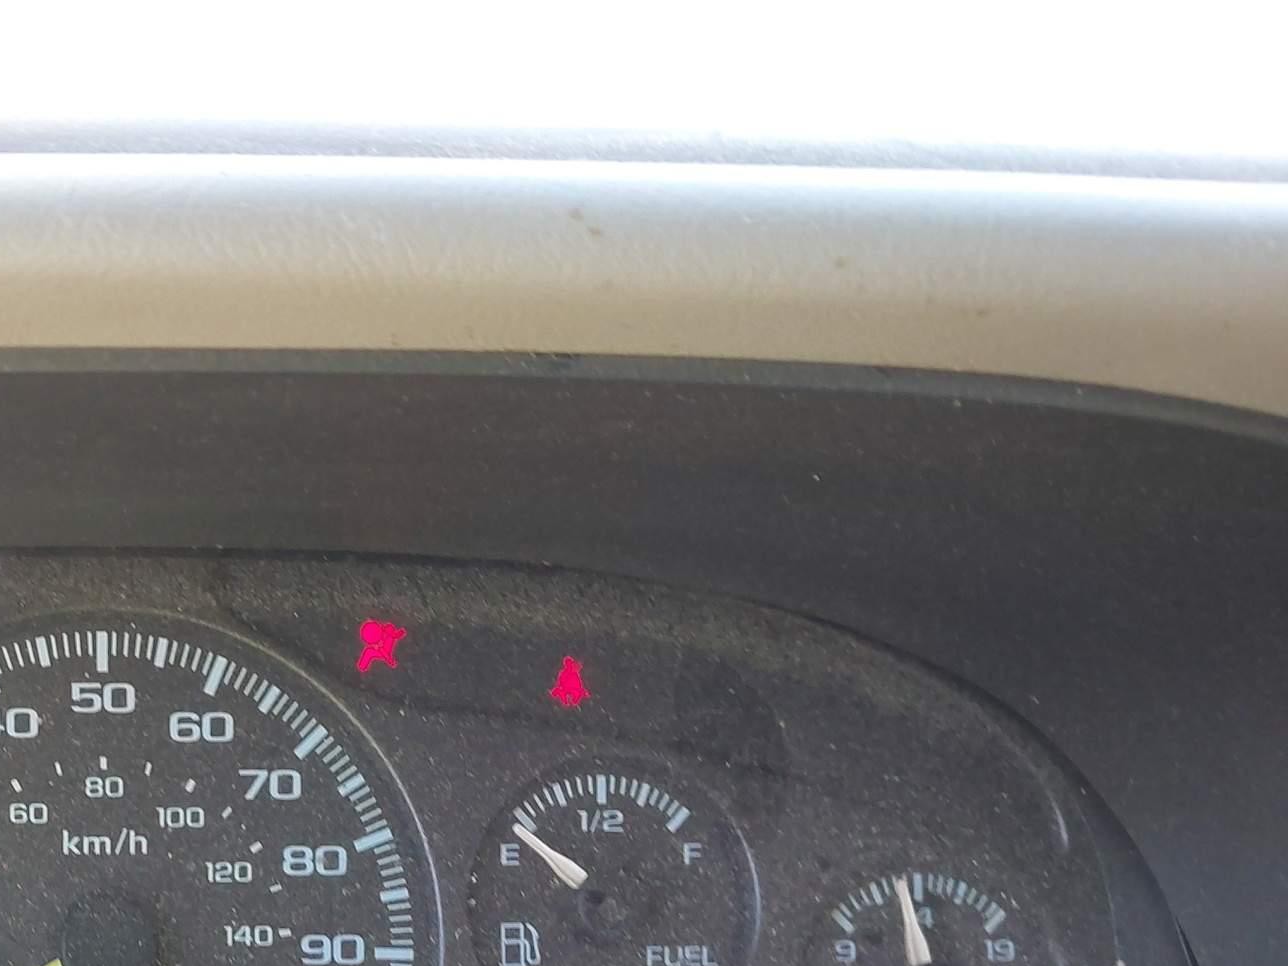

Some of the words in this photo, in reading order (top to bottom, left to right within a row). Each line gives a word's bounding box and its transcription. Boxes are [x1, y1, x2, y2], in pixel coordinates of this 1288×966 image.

[70, 681, 136, 714] 50
[169, 712, 234, 742] 60
[84, 776, 124, 799] 80
[238, 768, 302, 801] 70
[9, 803, 49, 824] 60
[156, 807, 205, 829] 100
[578, 808, 624, 833] 1/2
[62, 829, 148, 856] km/h
[683, 843, 702, 865] F
[282, 844, 348, 877] 80
[500, 844, 520, 867] E
[206, 860, 253, 883] 120
[224, 925, 273, 947] 140
[300, 934, 365, 966] 90
[834, 939, 857, 963] 9
[985, 939, 1014, 962] 19
